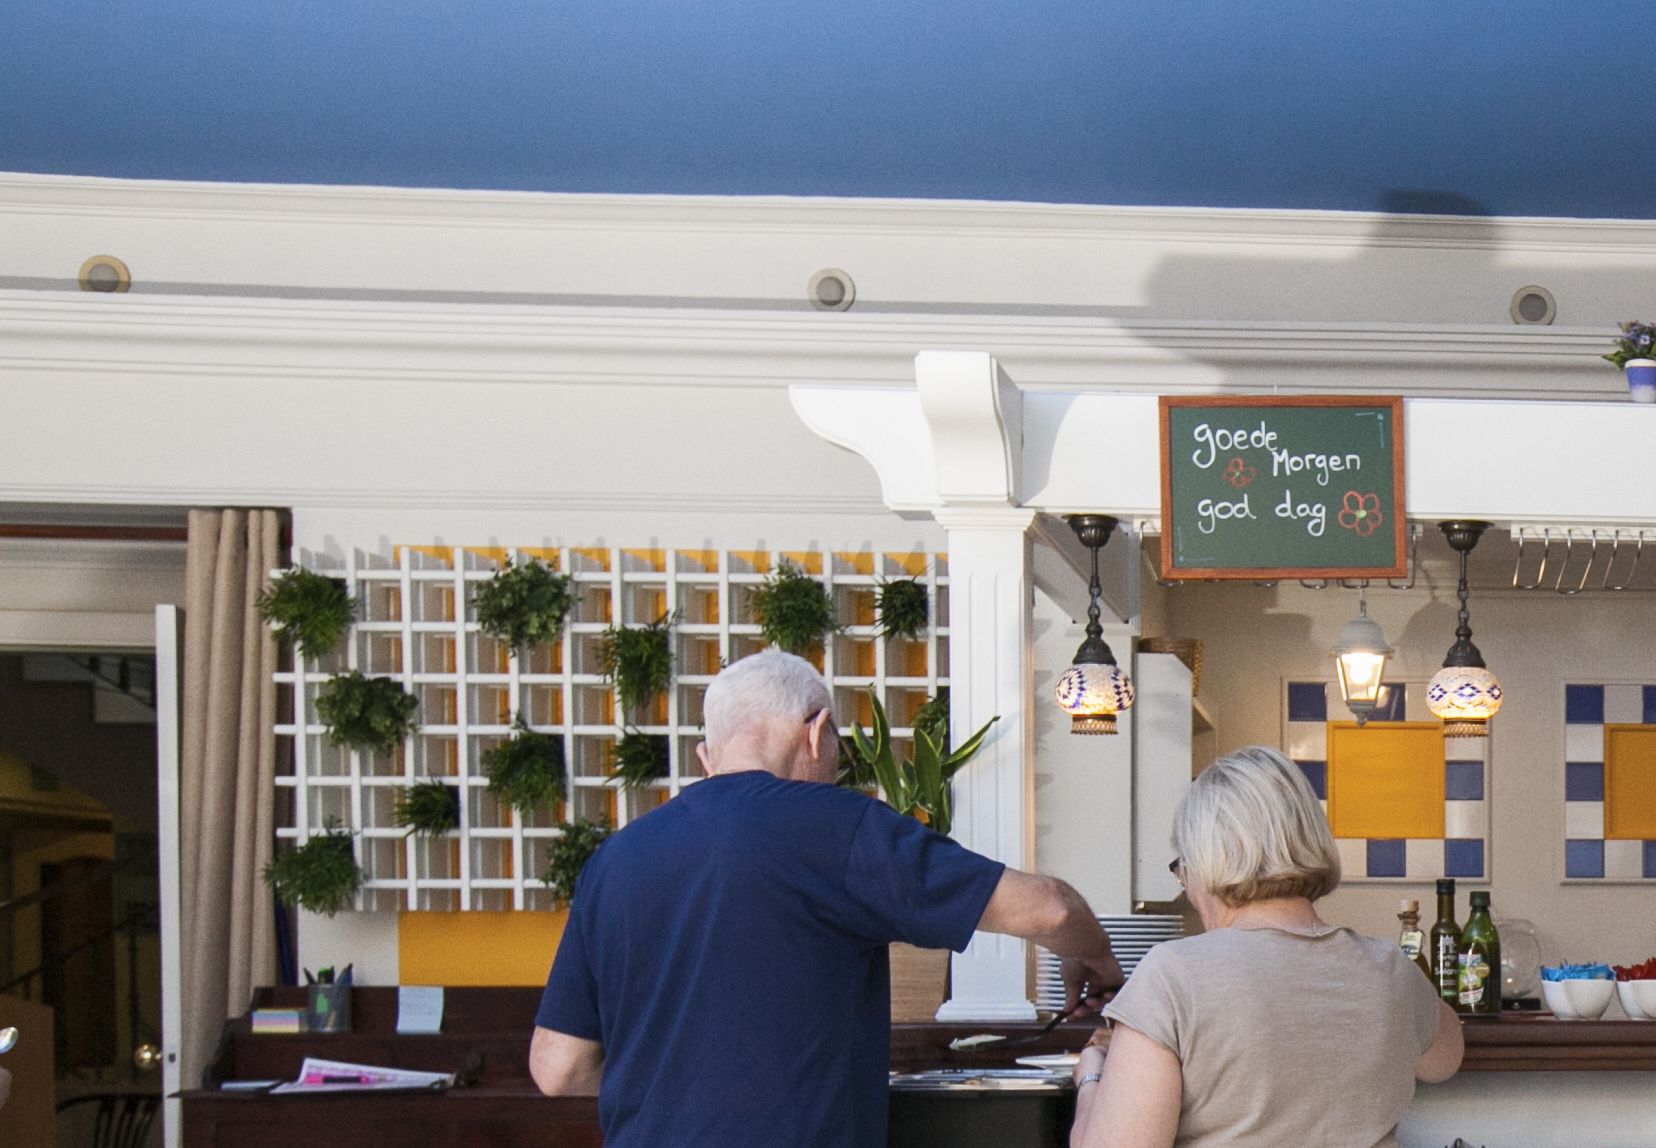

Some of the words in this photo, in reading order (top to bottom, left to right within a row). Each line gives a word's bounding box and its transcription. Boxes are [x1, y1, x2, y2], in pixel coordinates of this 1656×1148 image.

[1192, 420, 1278, 469] goede
[1271, 448, 1361, 486] Morgen
[1197, 493, 1257, 534] god
[1274, 489, 1327, 537] dag
